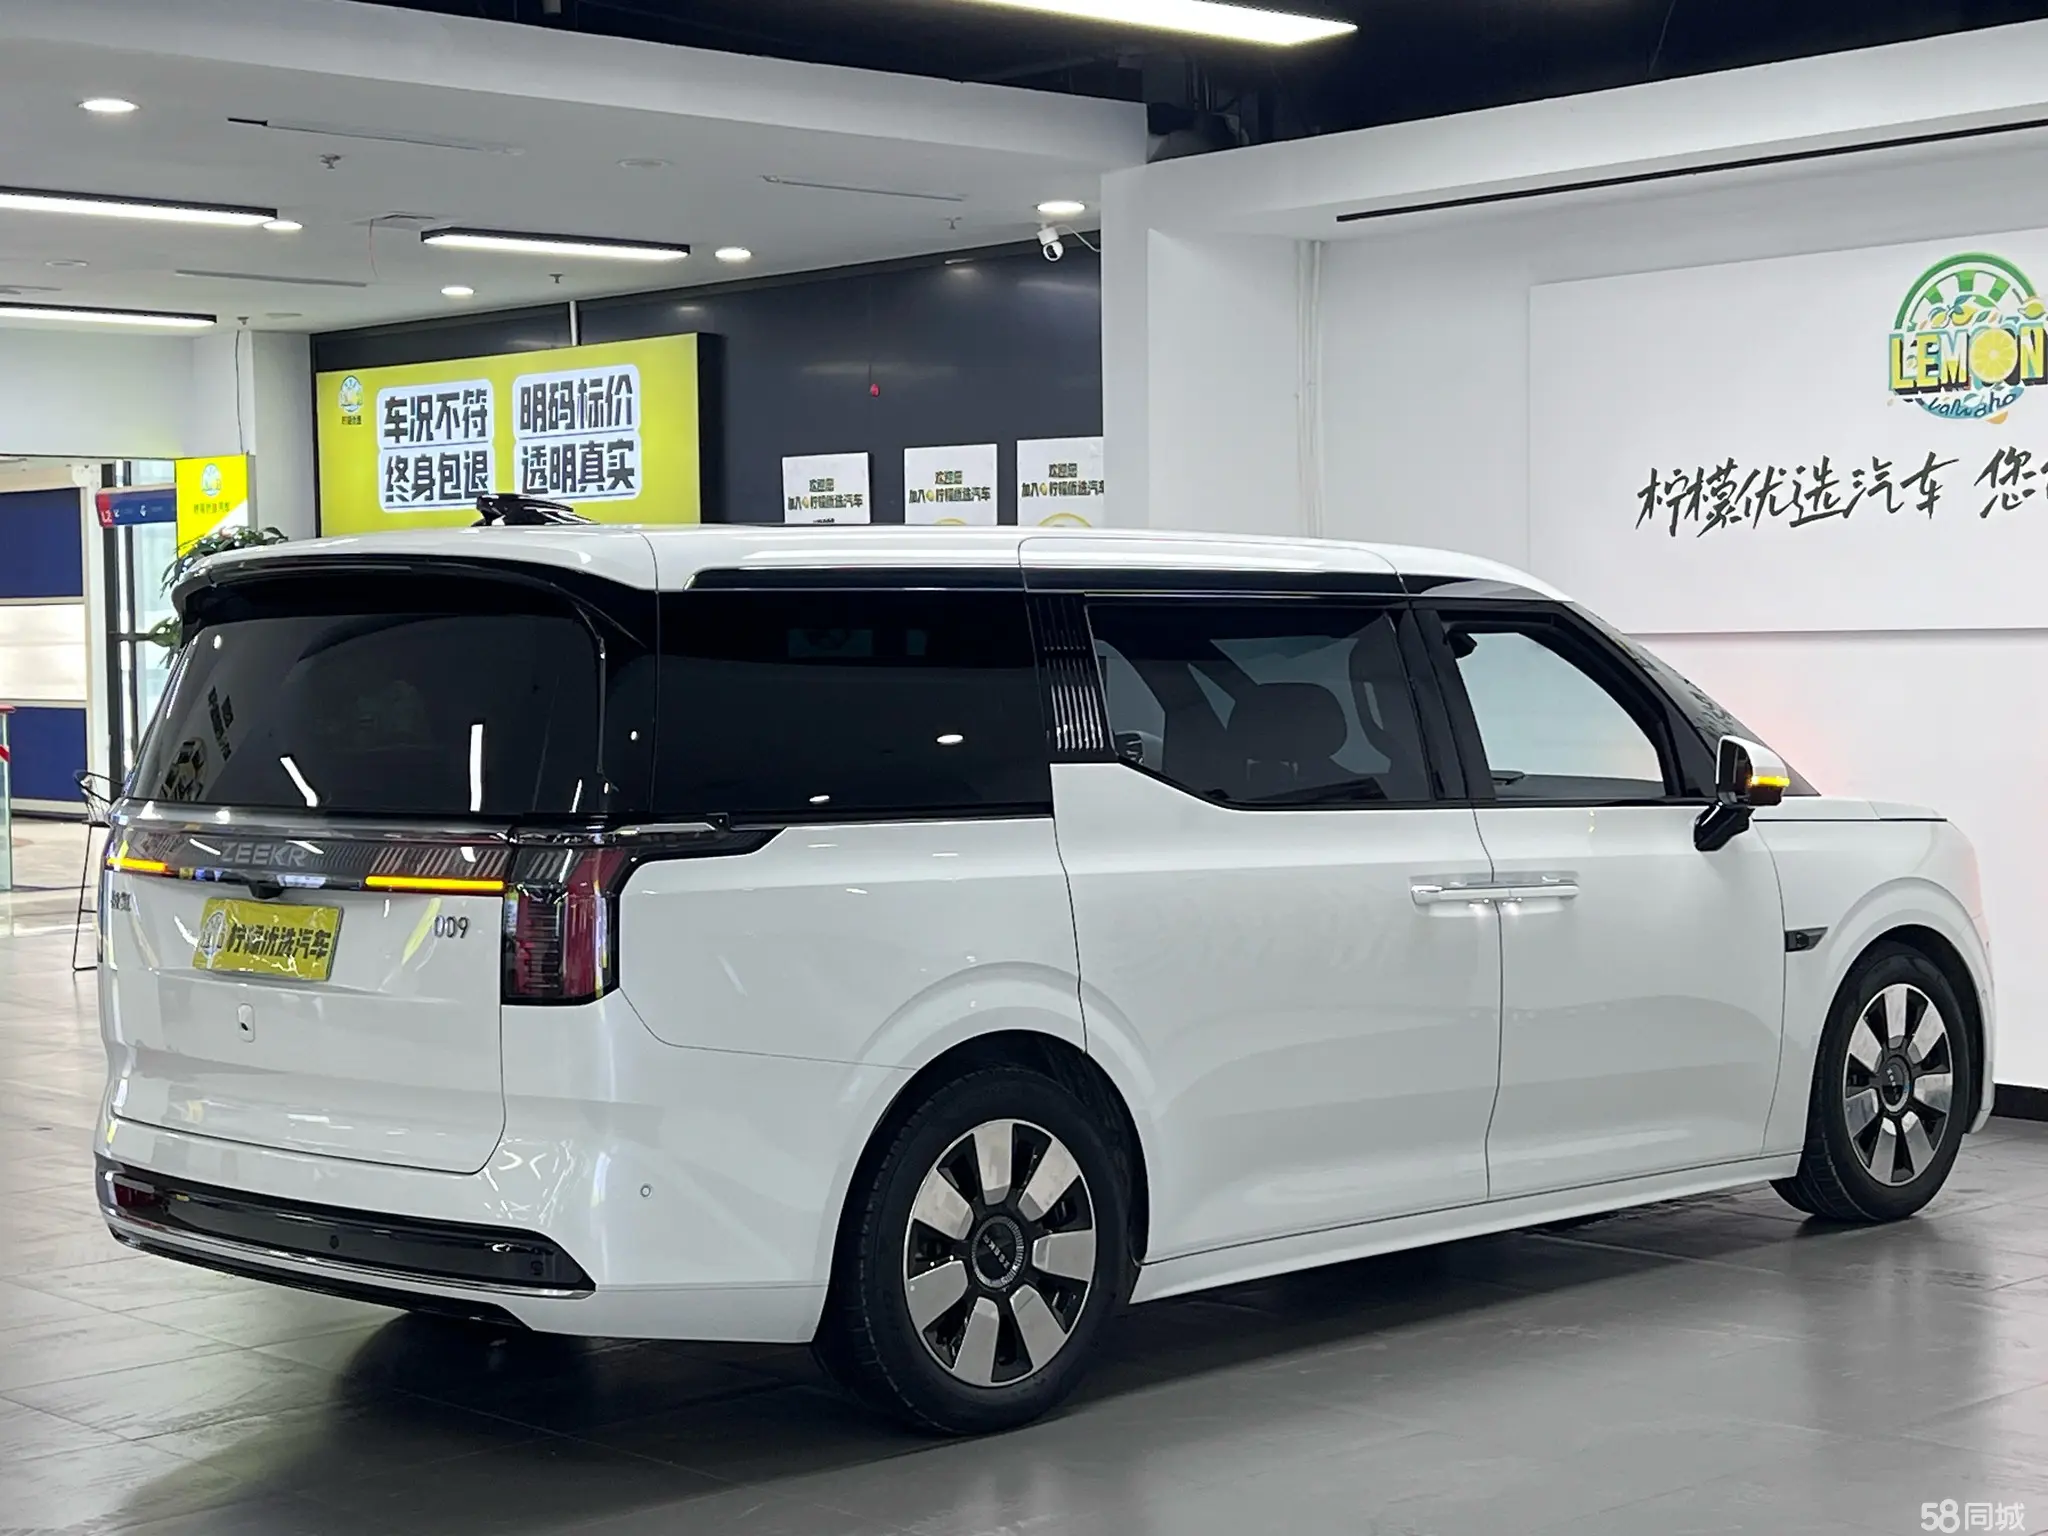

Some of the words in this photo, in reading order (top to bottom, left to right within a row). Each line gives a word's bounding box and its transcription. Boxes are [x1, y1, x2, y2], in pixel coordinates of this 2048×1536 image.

[1889, 323, 2048, 393] LEMON
[384, 388, 488, 444] 车况不符
[520, 374, 634, 433] 明码标价
[385, 450, 491, 502] 终身包退
[521, 438, 636, 496] 透明真实
[1635, 452, 1960, 538] 柠檬优选汽车
[221, 841, 308, 867] ZEEKR
[435, 915, 470, 939] 009
